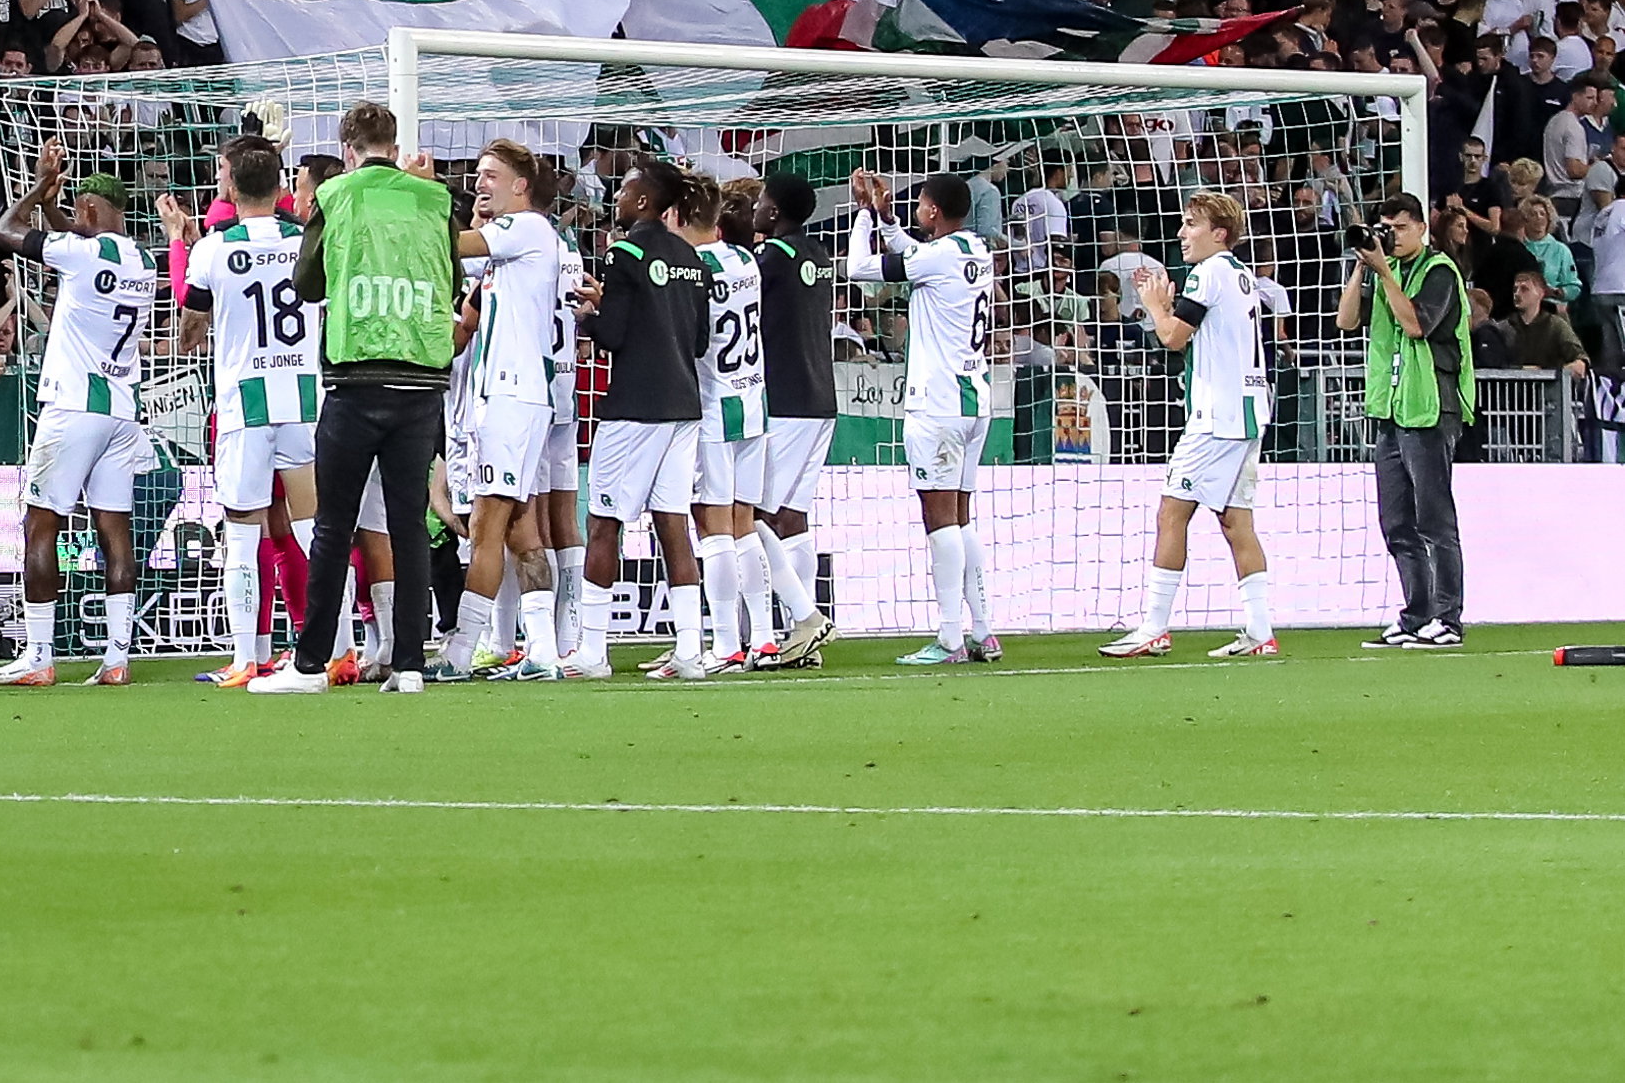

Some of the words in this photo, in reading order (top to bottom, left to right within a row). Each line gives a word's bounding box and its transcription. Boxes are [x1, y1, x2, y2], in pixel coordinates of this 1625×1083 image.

[256, 252, 299, 266] SPOR
[560, 263, 583, 275] PORT
[670, 267, 703, 281] SPORT
[119, 280, 155, 294] SPORT
[732, 274, 759, 293] SPORT
[242, 278, 306, 347] 18
[972, 290, 988, 352] 6
[113, 304, 138, 363] 7
[716, 303, 760, 374] 25
[253, 356, 268, 370] DE
[269, 354, 304, 369] JONGE
[479, 463, 494, 484] 10
